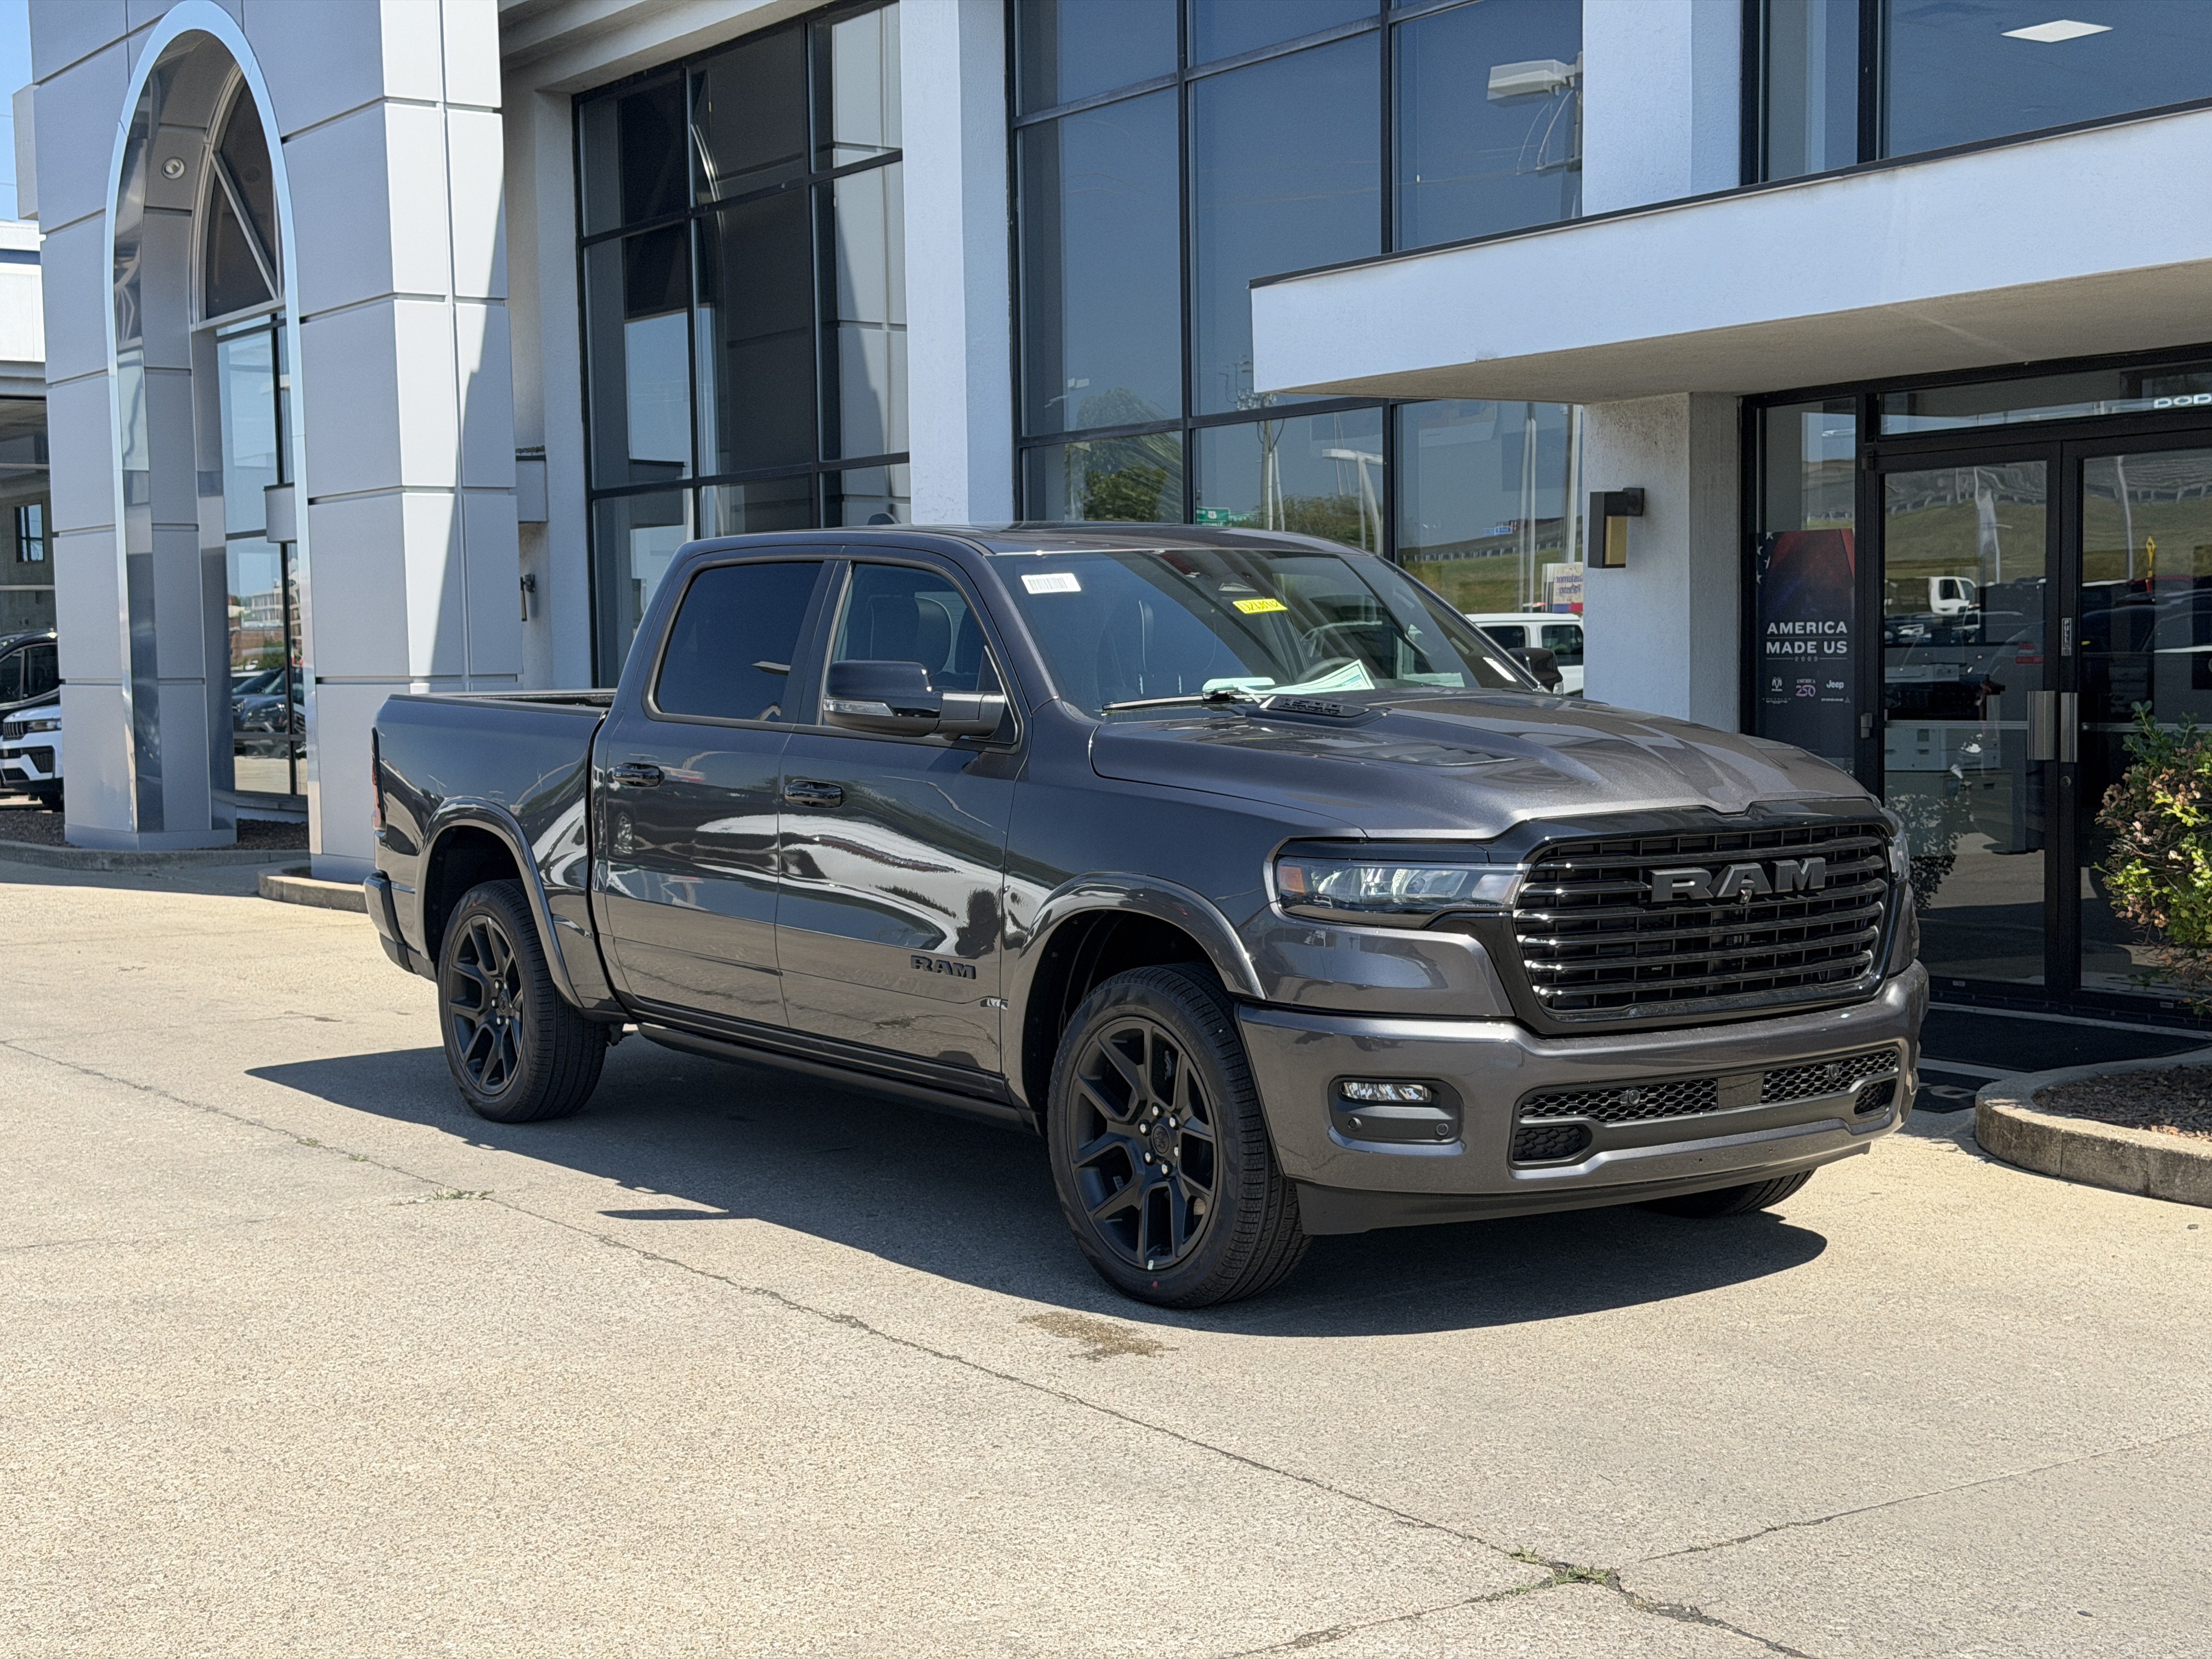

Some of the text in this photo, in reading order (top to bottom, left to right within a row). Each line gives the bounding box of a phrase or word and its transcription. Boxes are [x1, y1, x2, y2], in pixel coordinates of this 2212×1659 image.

[1767, 621, 1847, 634] AMERICA
[1766, 641, 1847, 654] MADE US
[1795, 685, 1816, 697] 250
[1826, 680, 1844, 690] Jeep
[1650, 857, 1826, 902] RAM
[910, 955, 977, 980] RAM
